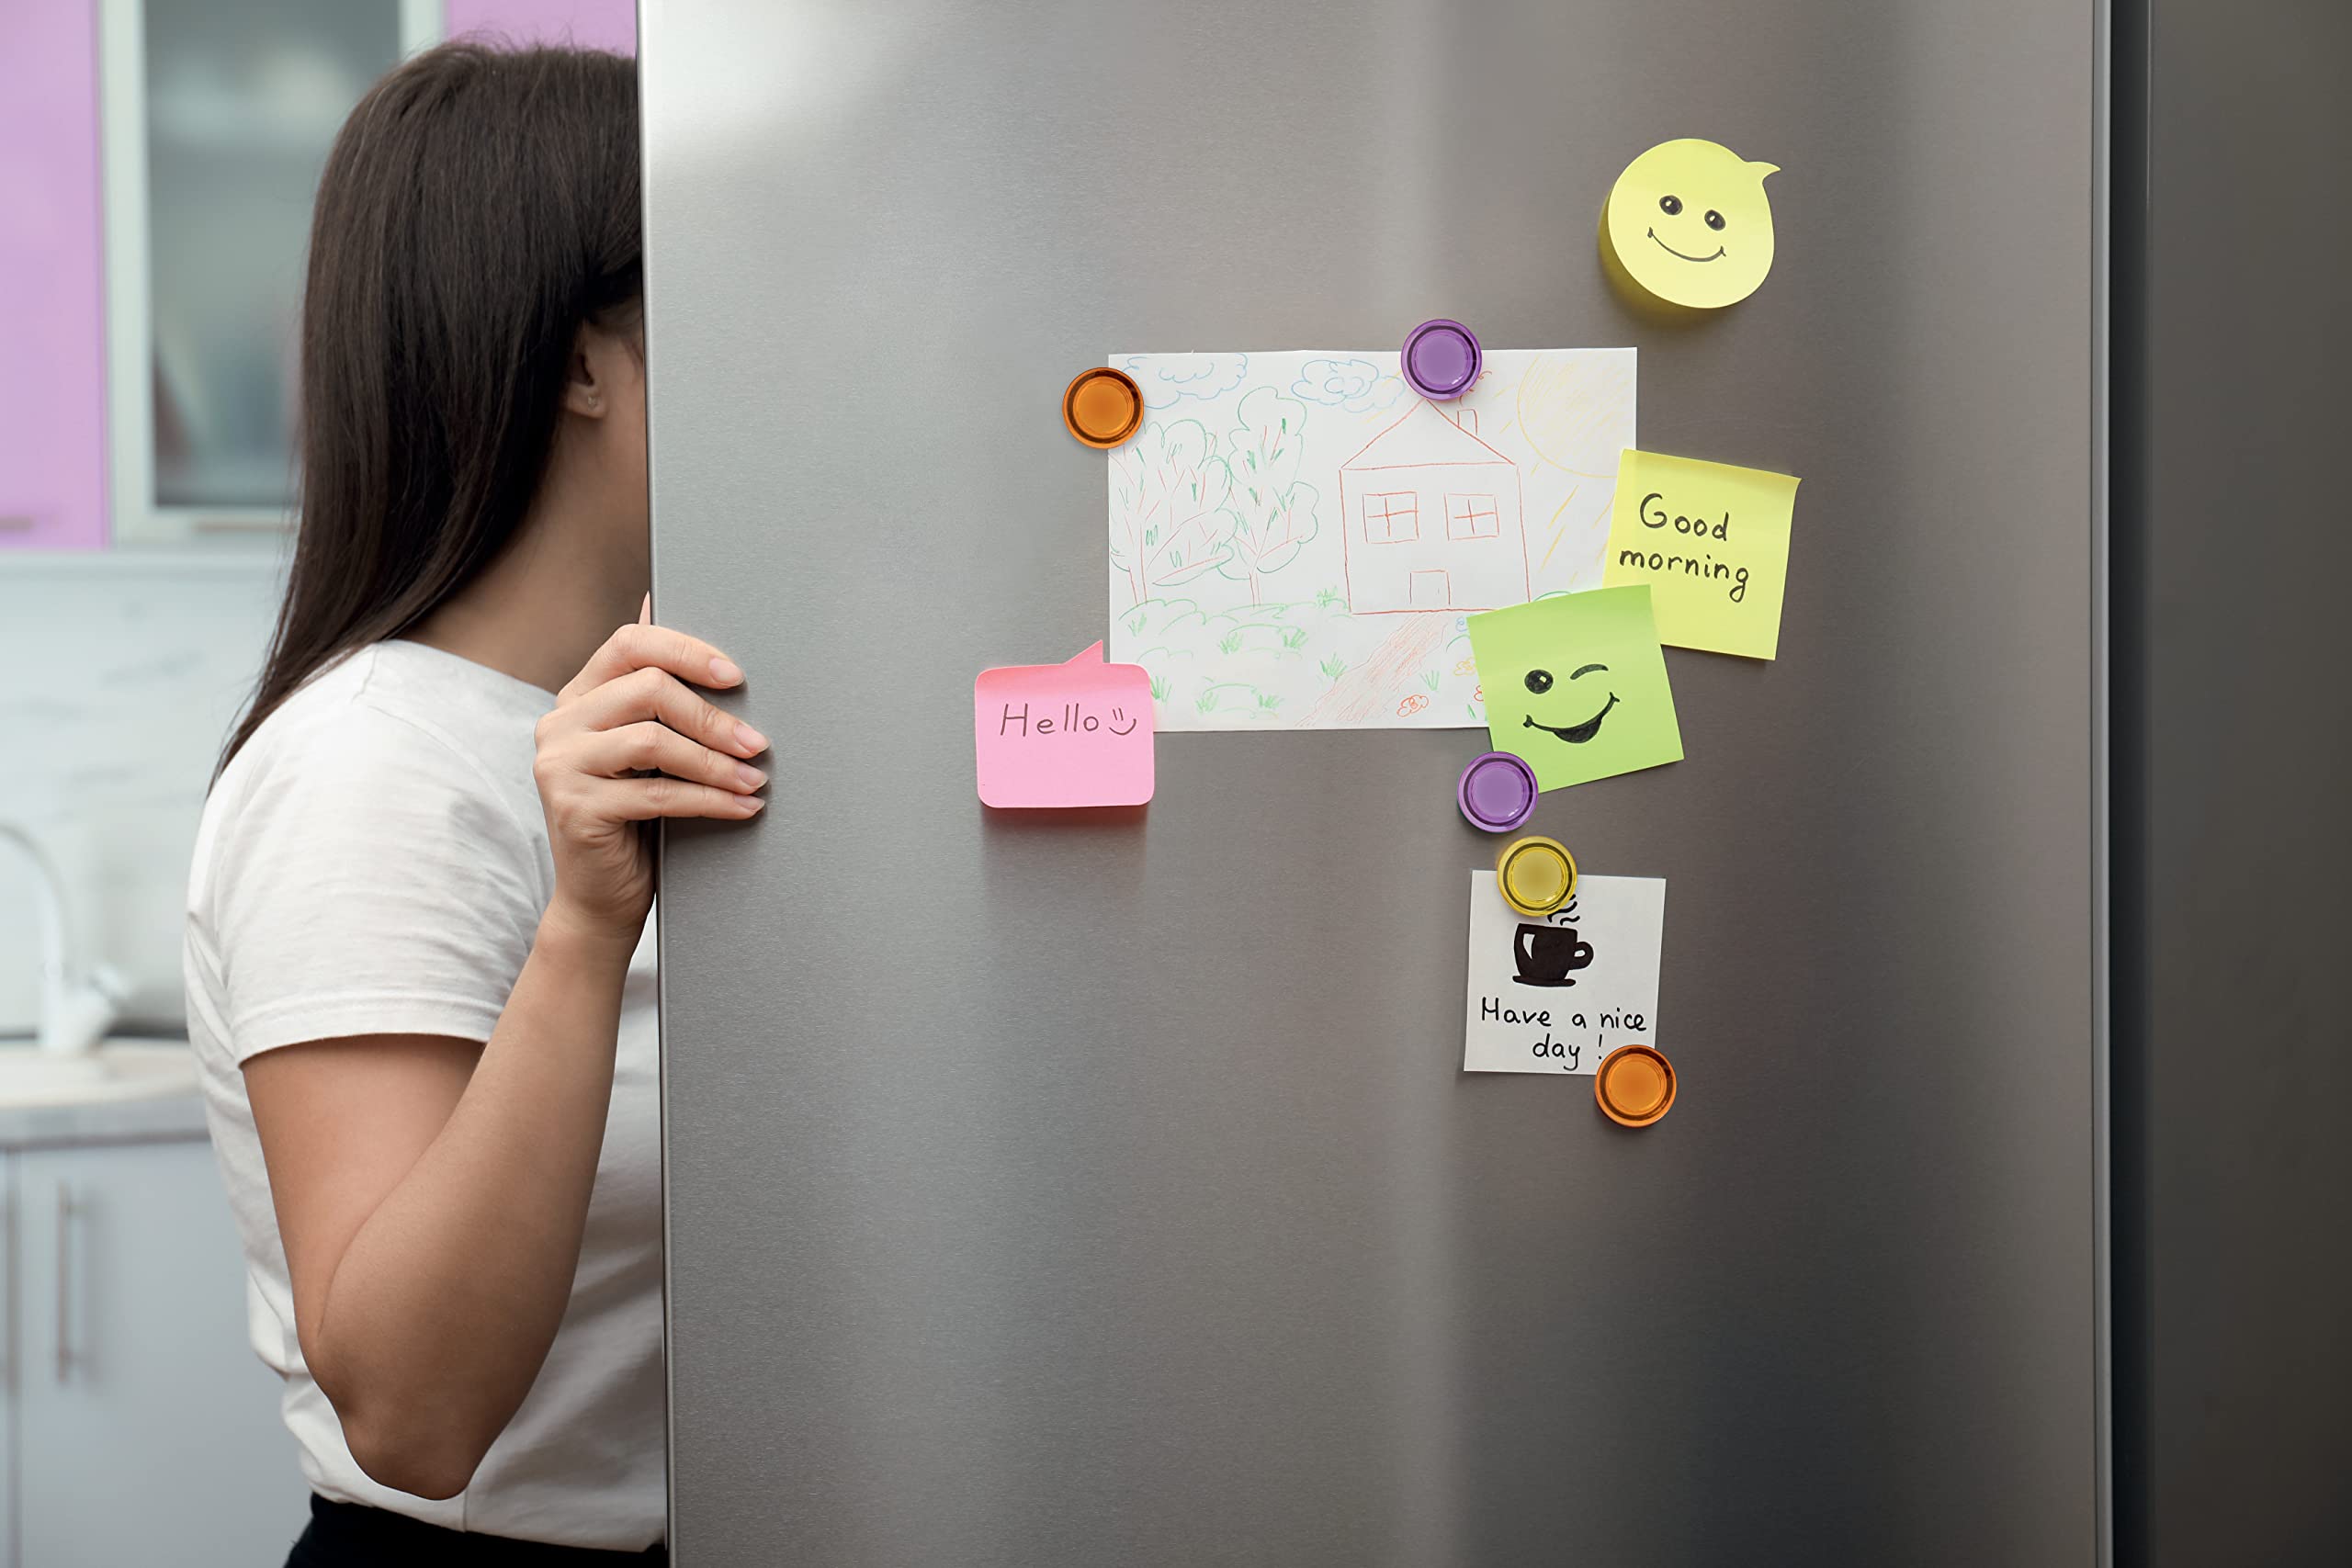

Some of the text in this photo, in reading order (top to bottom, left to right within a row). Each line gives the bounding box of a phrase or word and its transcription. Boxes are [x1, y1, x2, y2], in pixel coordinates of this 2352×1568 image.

[1639, 492, 1729, 542] Good
[1619, 549, 1749, 604] morning
[1000, 702, 1100, 738] Hello
[1481, 996, 1647, 1032] Have a nice
